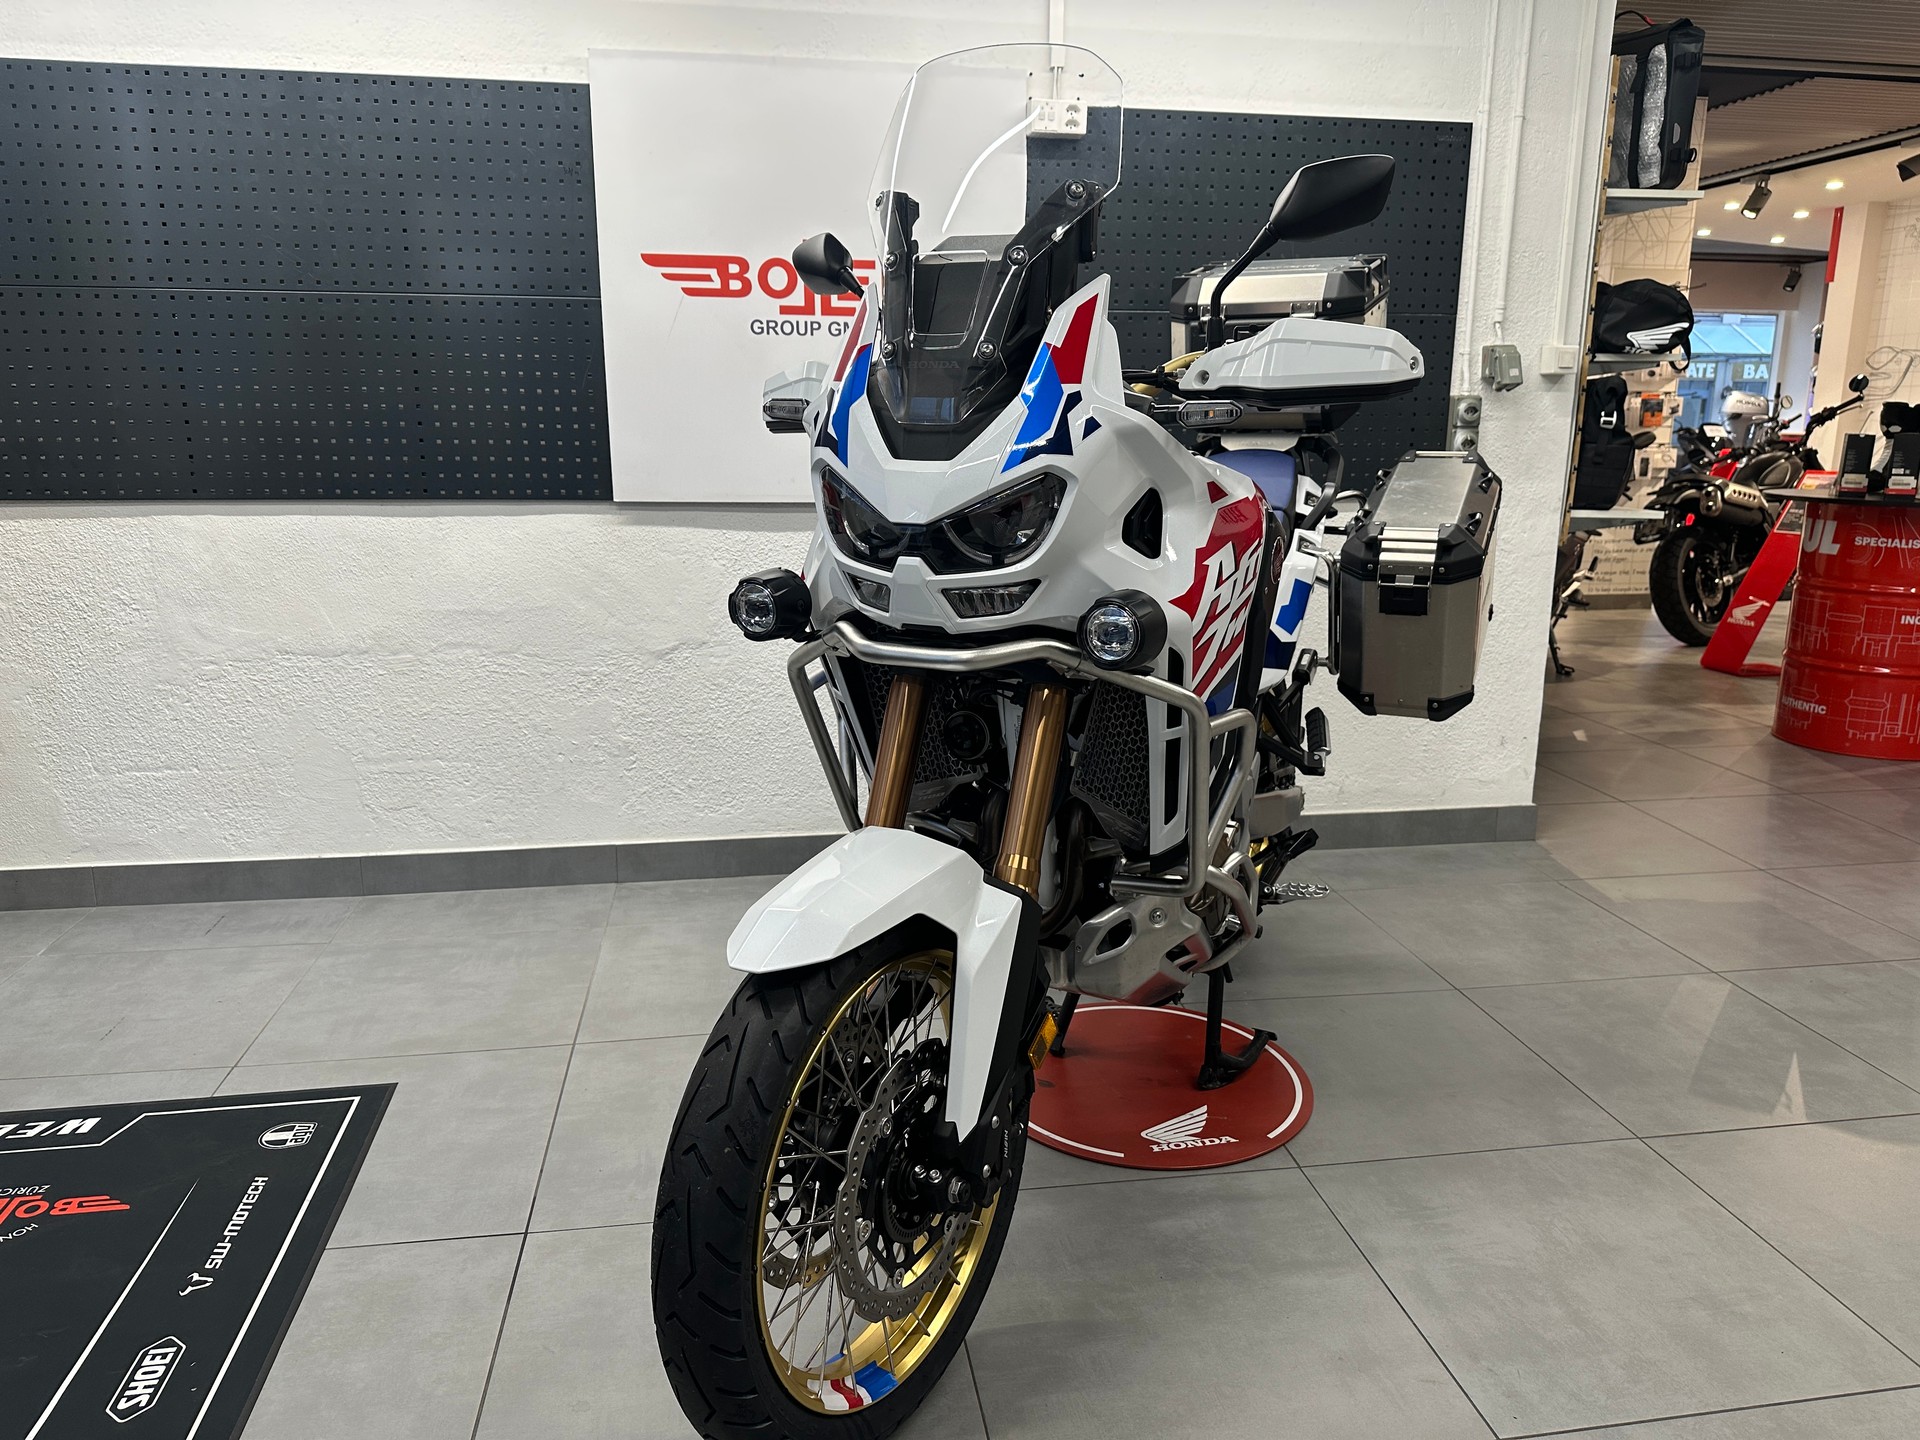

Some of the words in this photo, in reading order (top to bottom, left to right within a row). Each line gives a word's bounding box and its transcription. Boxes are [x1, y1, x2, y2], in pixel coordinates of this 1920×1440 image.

[750, 319, 821, 337] GROUP
[907, 360, 961, 369] HONDA
[1149, 1136, 1240, 1153] HONDA
[204, 1176, 269, 1270] SW-MOTECH
[116, 1346, 178, 1410] SHOEI
